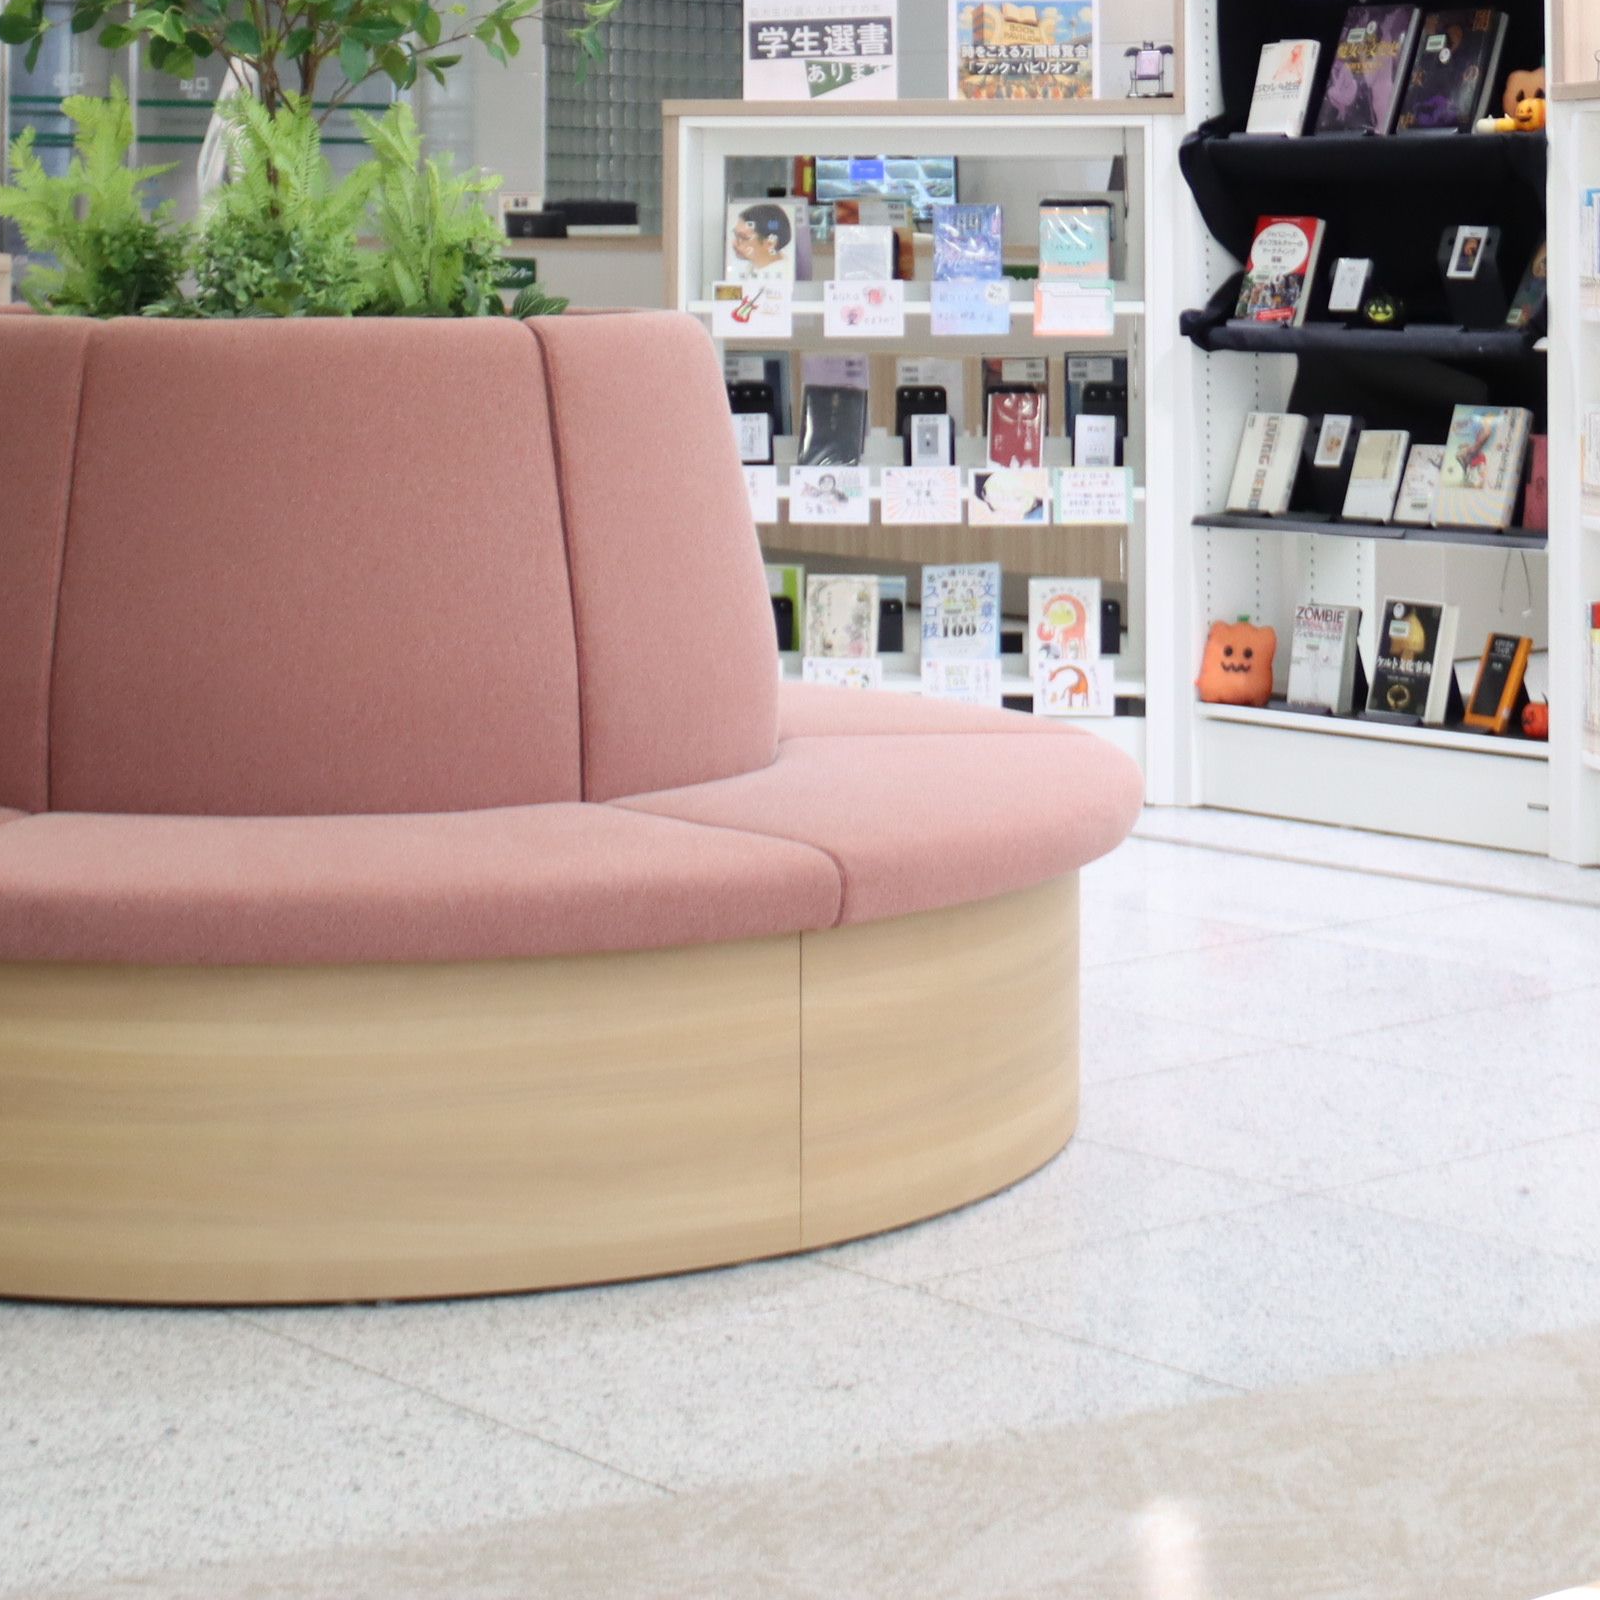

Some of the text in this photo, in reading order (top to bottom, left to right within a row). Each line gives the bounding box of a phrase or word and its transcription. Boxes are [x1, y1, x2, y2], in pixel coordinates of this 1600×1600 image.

[1009, 24, 1035, 34] BOOK
[757, 22, 888, 58] 学生選書
[1003, 32, 1041, 43] PAVILION
[961, 44, 1089, 58] 時をこえる万国博覧会
[1297, 606, 1345, 624] ZOMBIE
[943, 623, 977, 638] 100
